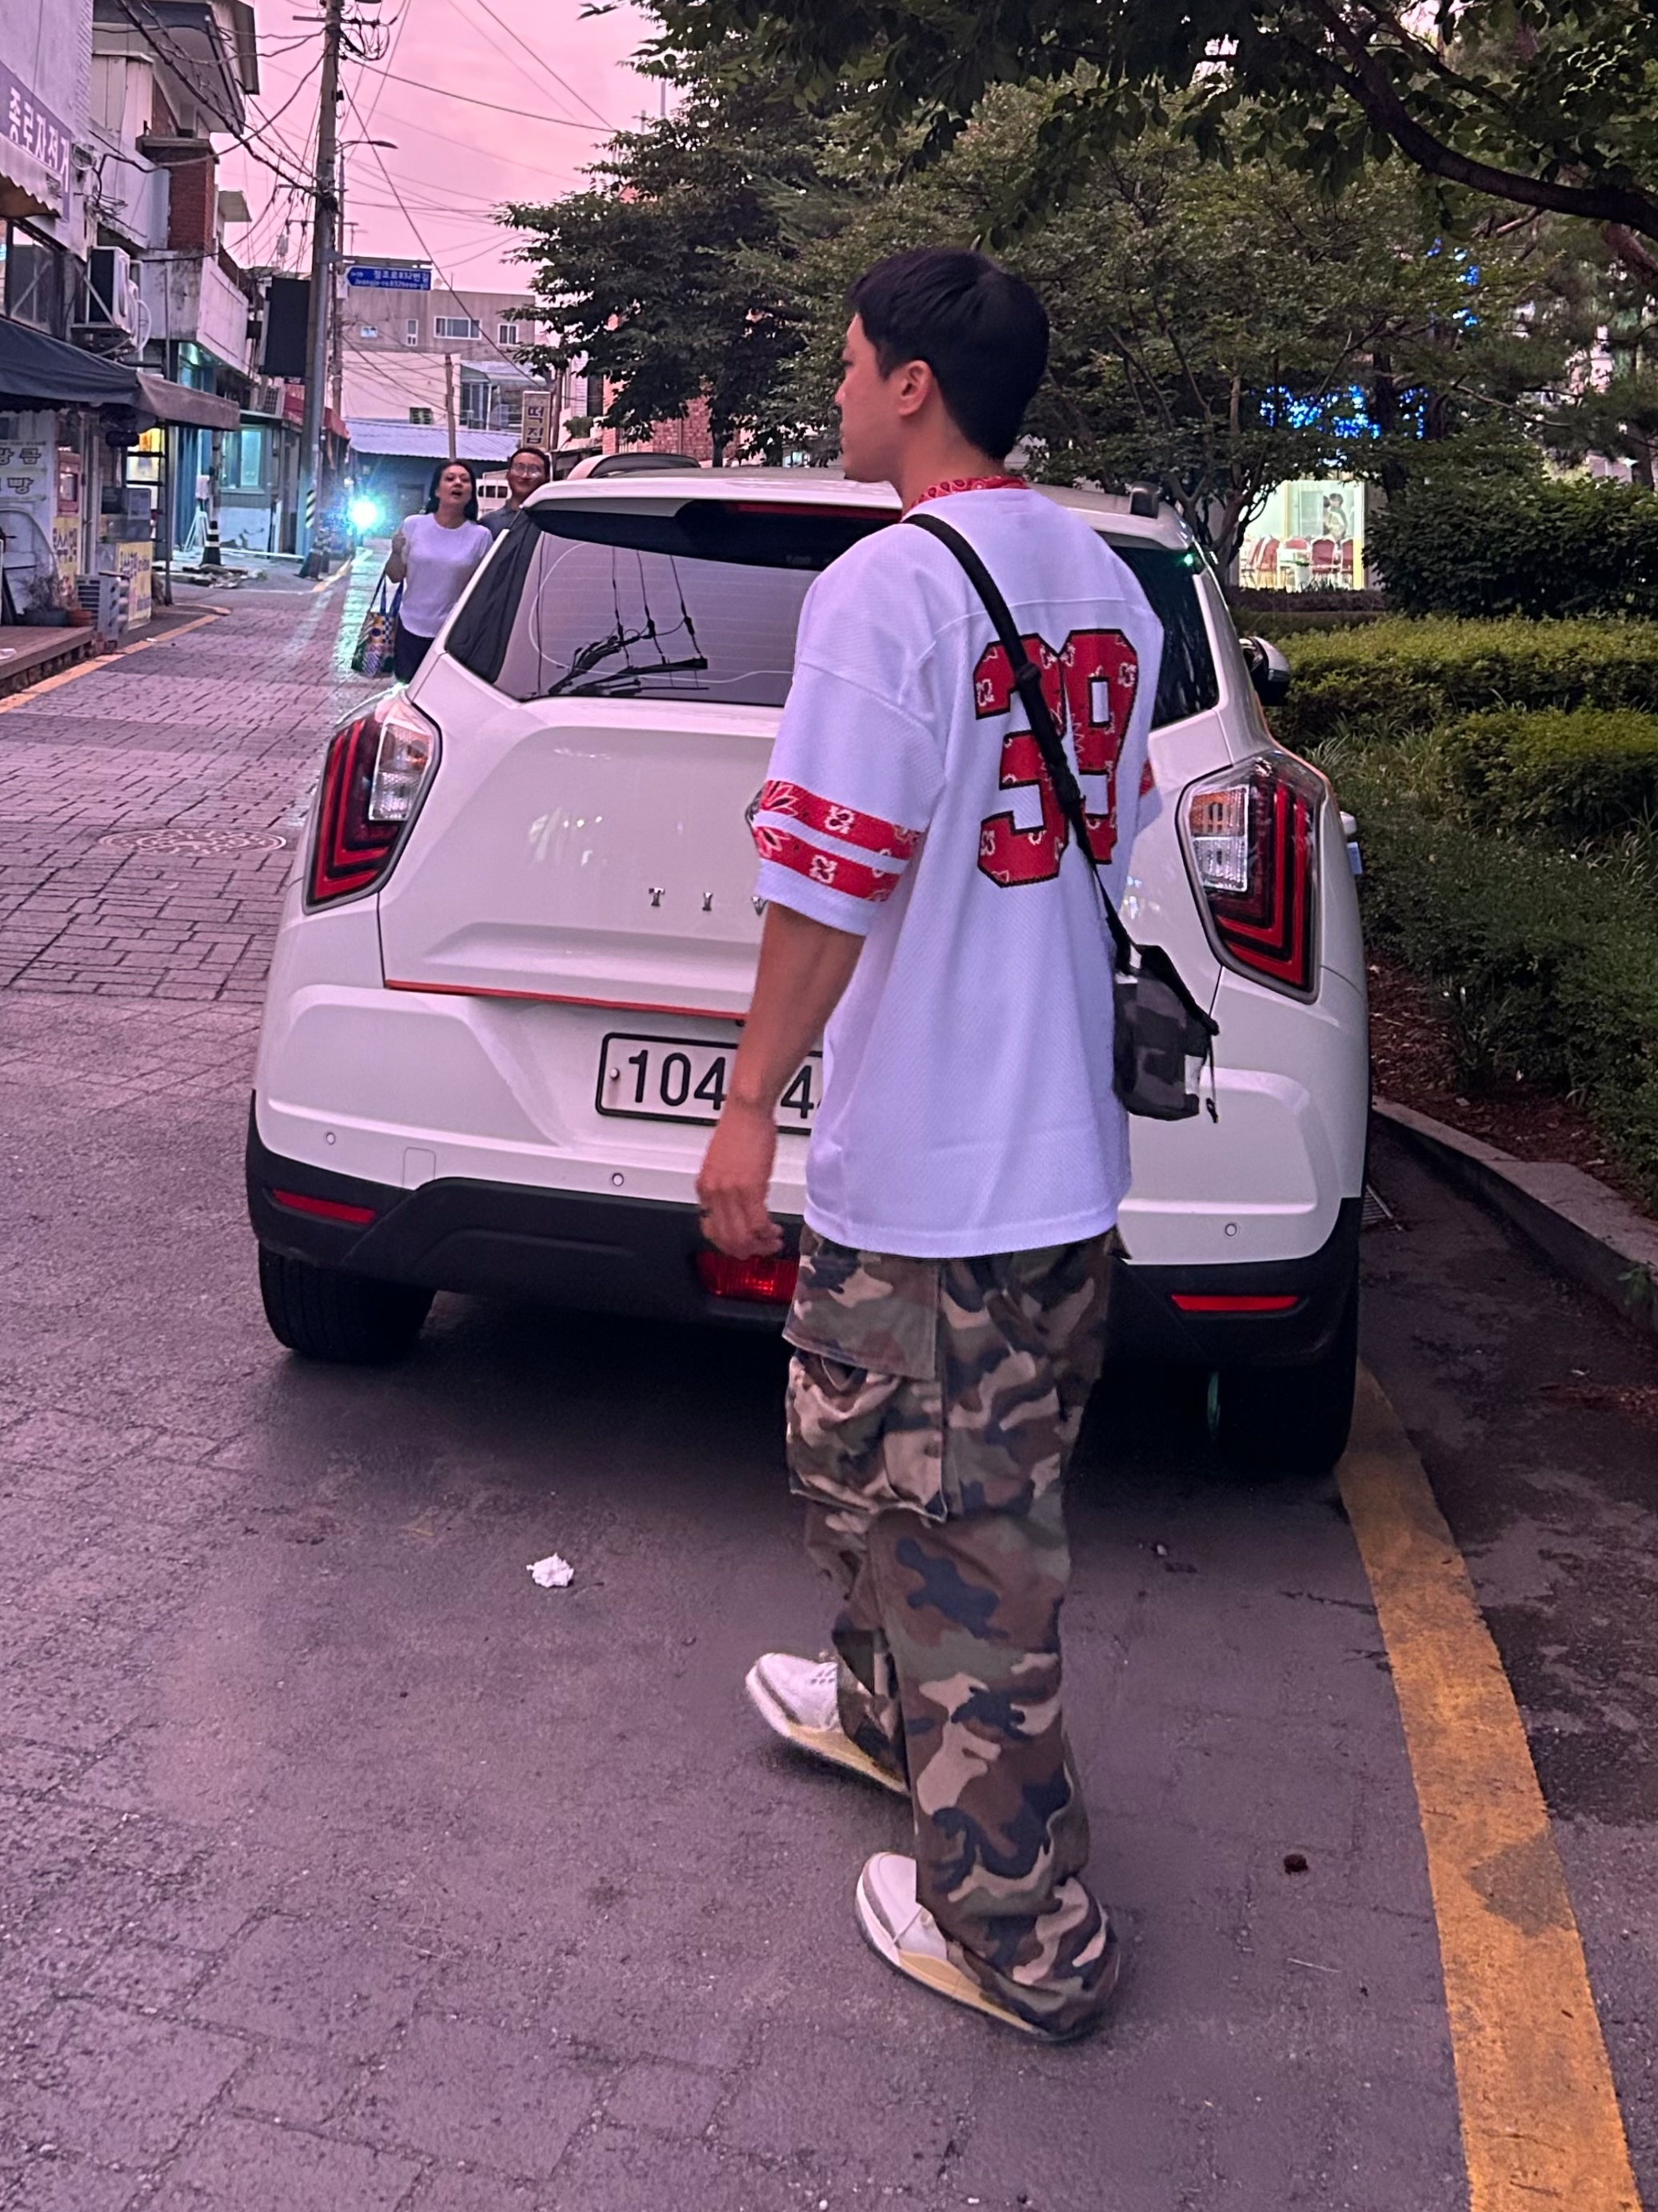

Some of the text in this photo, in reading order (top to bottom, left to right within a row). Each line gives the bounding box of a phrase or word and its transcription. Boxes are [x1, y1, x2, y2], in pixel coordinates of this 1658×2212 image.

[973, 628, 1139, 888] 39
[649, 886, 768, 916] TIV
[629, 1050, 727, 1111] 104
